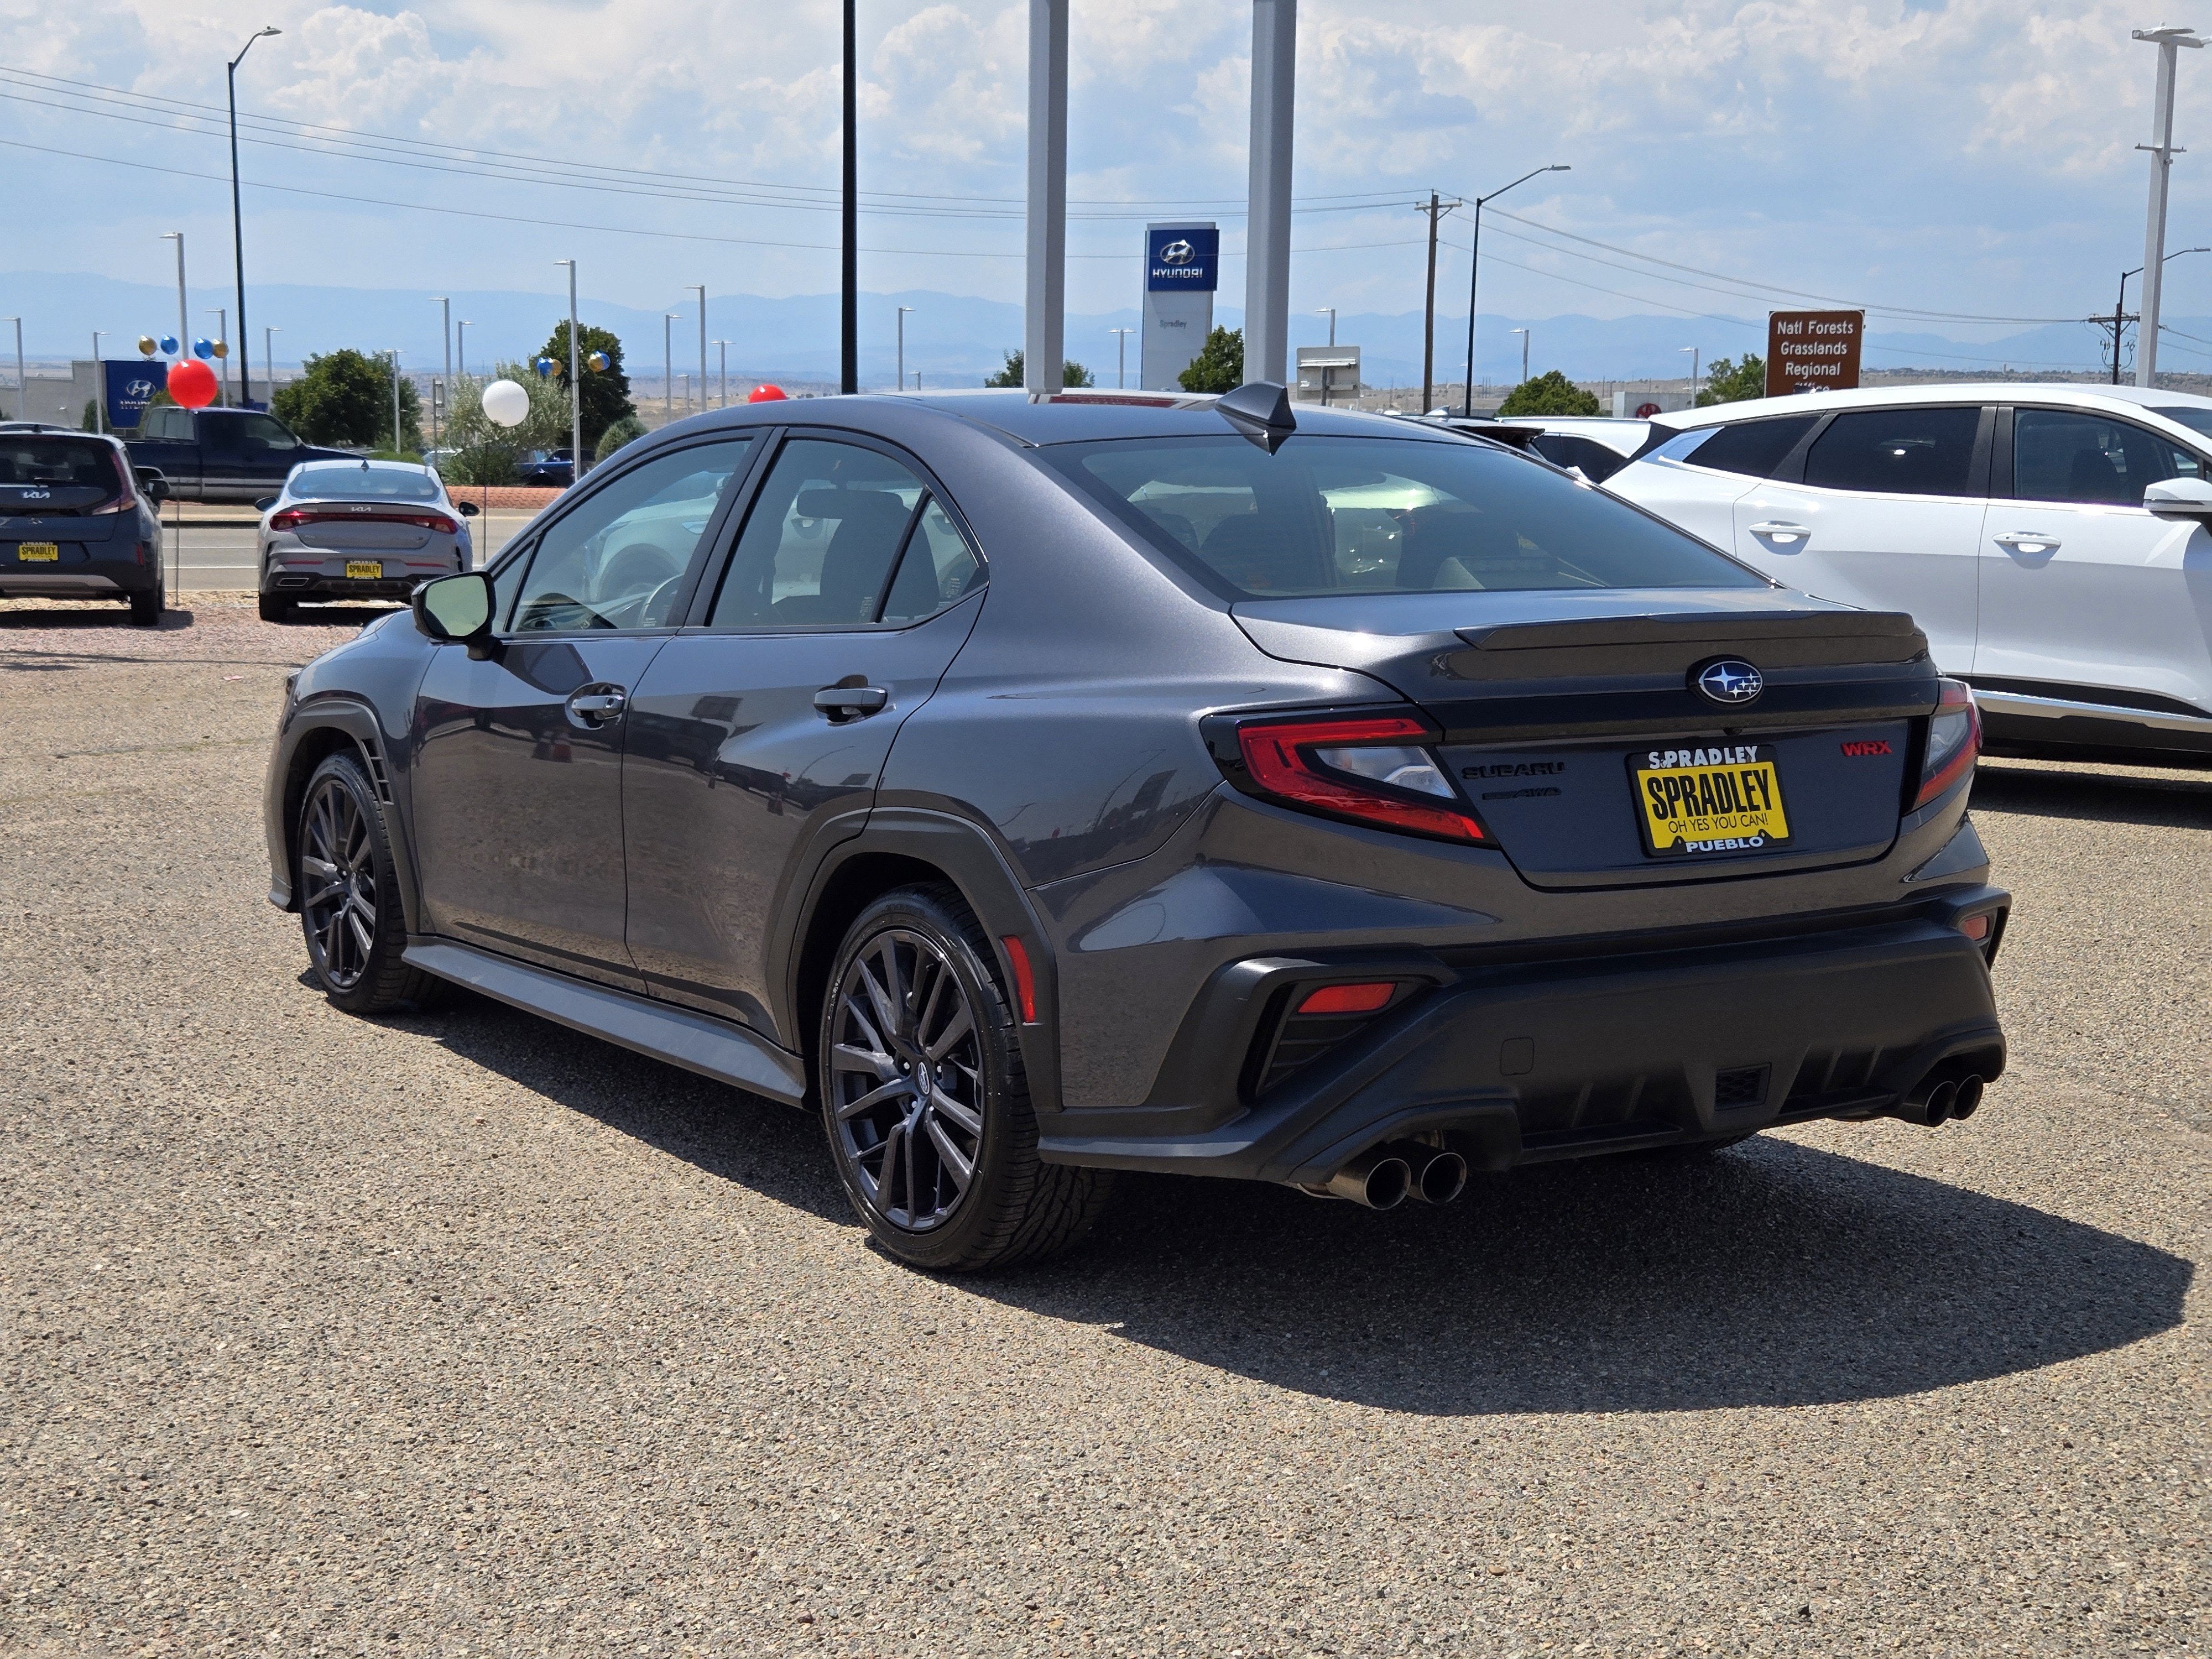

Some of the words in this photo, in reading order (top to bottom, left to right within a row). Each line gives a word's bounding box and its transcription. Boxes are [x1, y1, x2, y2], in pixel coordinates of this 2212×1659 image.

[1152, 268, 1203, 278] HYUNDAI
[1160, 320, 1187, 329] Spradley
[1777, 321, 1803, 335] Natl
[1808, 320, 1854, 335] Forests
[1781, 341, 1848, 356] Grasslands
[1785, 361, 1841, 379] Regional
[22, 546, 56, 555] SPRADLEY
[348, 565, 380, 573] SPRADLEY
[1648, 745, 1758, 769] SPRADLEY
[1841, 740, 1892, 757] WRX
[1462, 758, 1564, 779] SUBARU
[1647, 769, 1772, 820] SPRADLEY
[1668, 820, 1688, 834] OH
[1689, 818, 1710, 832] YES
[1711, 815, 1738, 830] YOU
[1740, 812, 1769, 827] CAN!
[1685, 836, 1764, 853] PUEBLO
